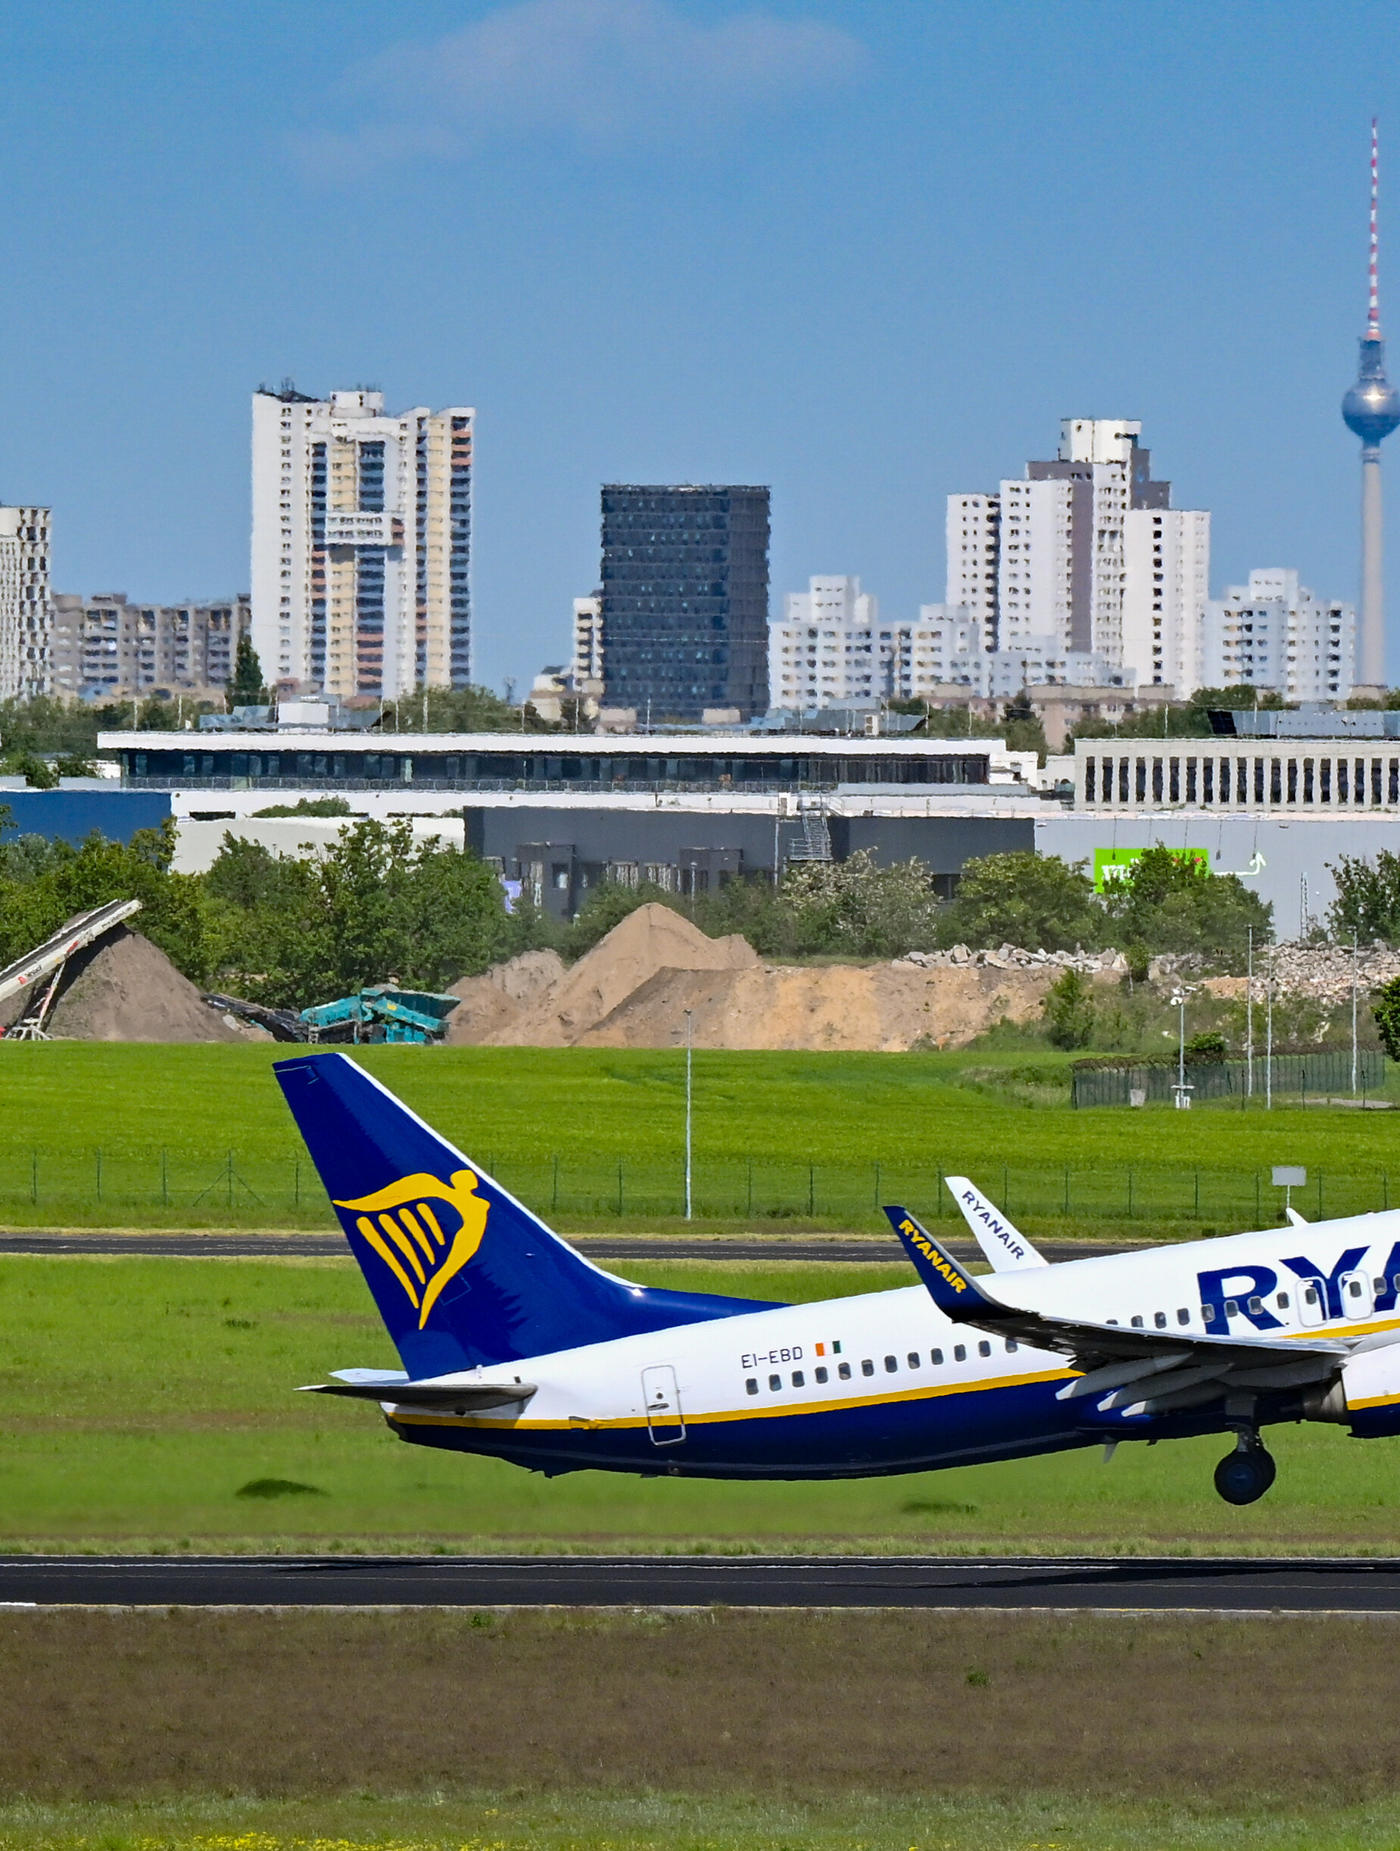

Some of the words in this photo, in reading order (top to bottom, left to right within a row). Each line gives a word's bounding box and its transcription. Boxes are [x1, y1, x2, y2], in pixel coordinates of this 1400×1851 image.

[898, 1219, 967, 1294] RYANAIR
[962, 1190, 1025, 1260] RYANAIR
[741, 1346, 803, 1369] EI-EBD
